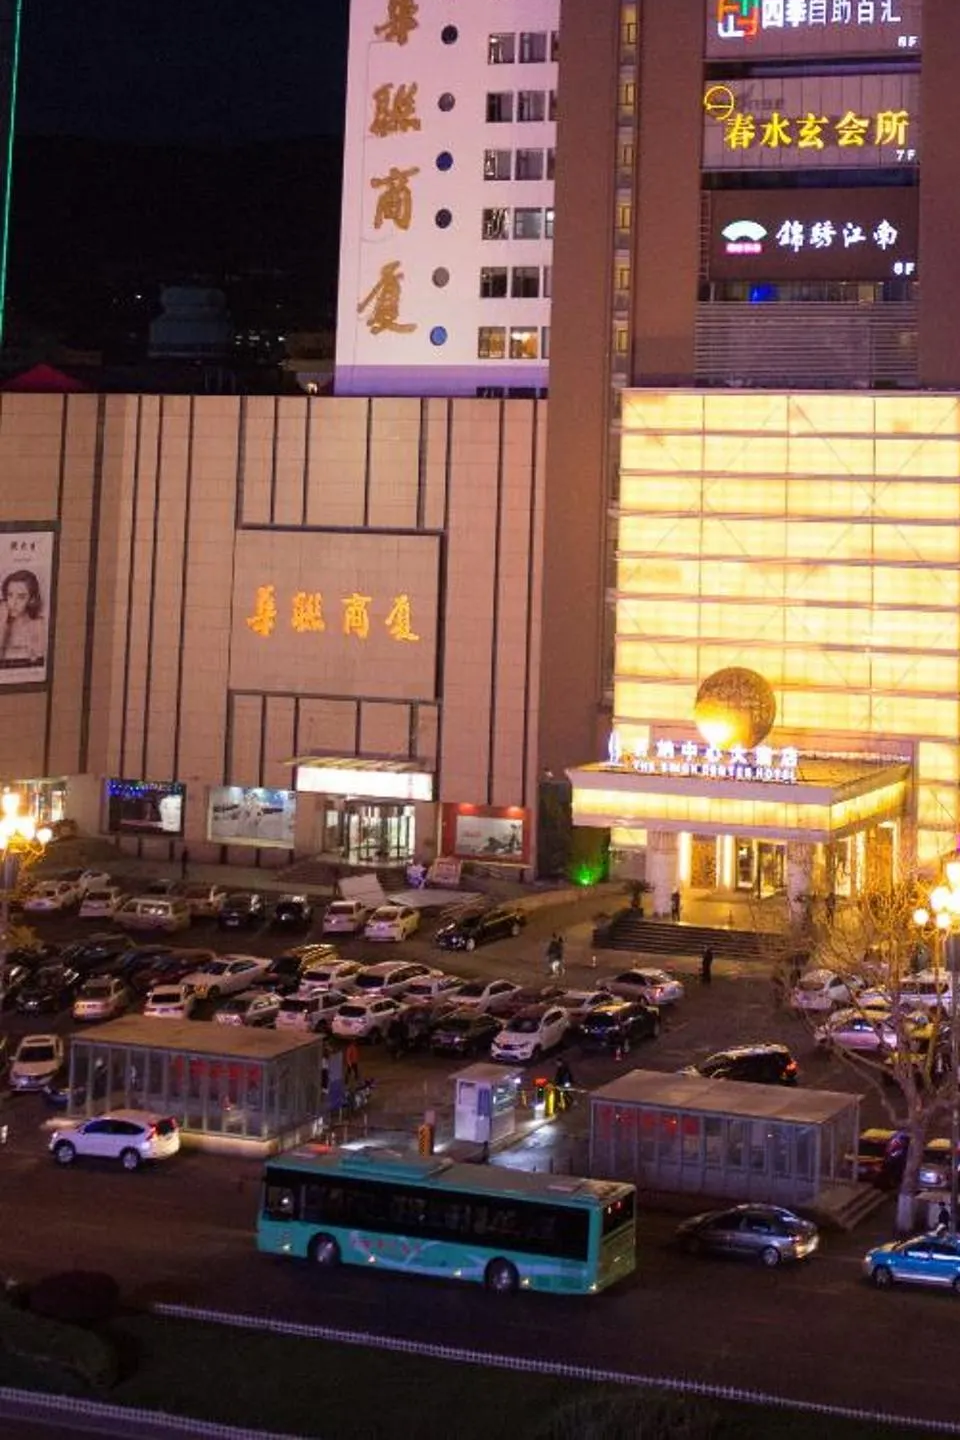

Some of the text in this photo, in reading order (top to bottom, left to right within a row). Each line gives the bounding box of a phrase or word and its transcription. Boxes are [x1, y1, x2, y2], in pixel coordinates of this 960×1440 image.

[724, 109, 910, 149] 春水玄会所
